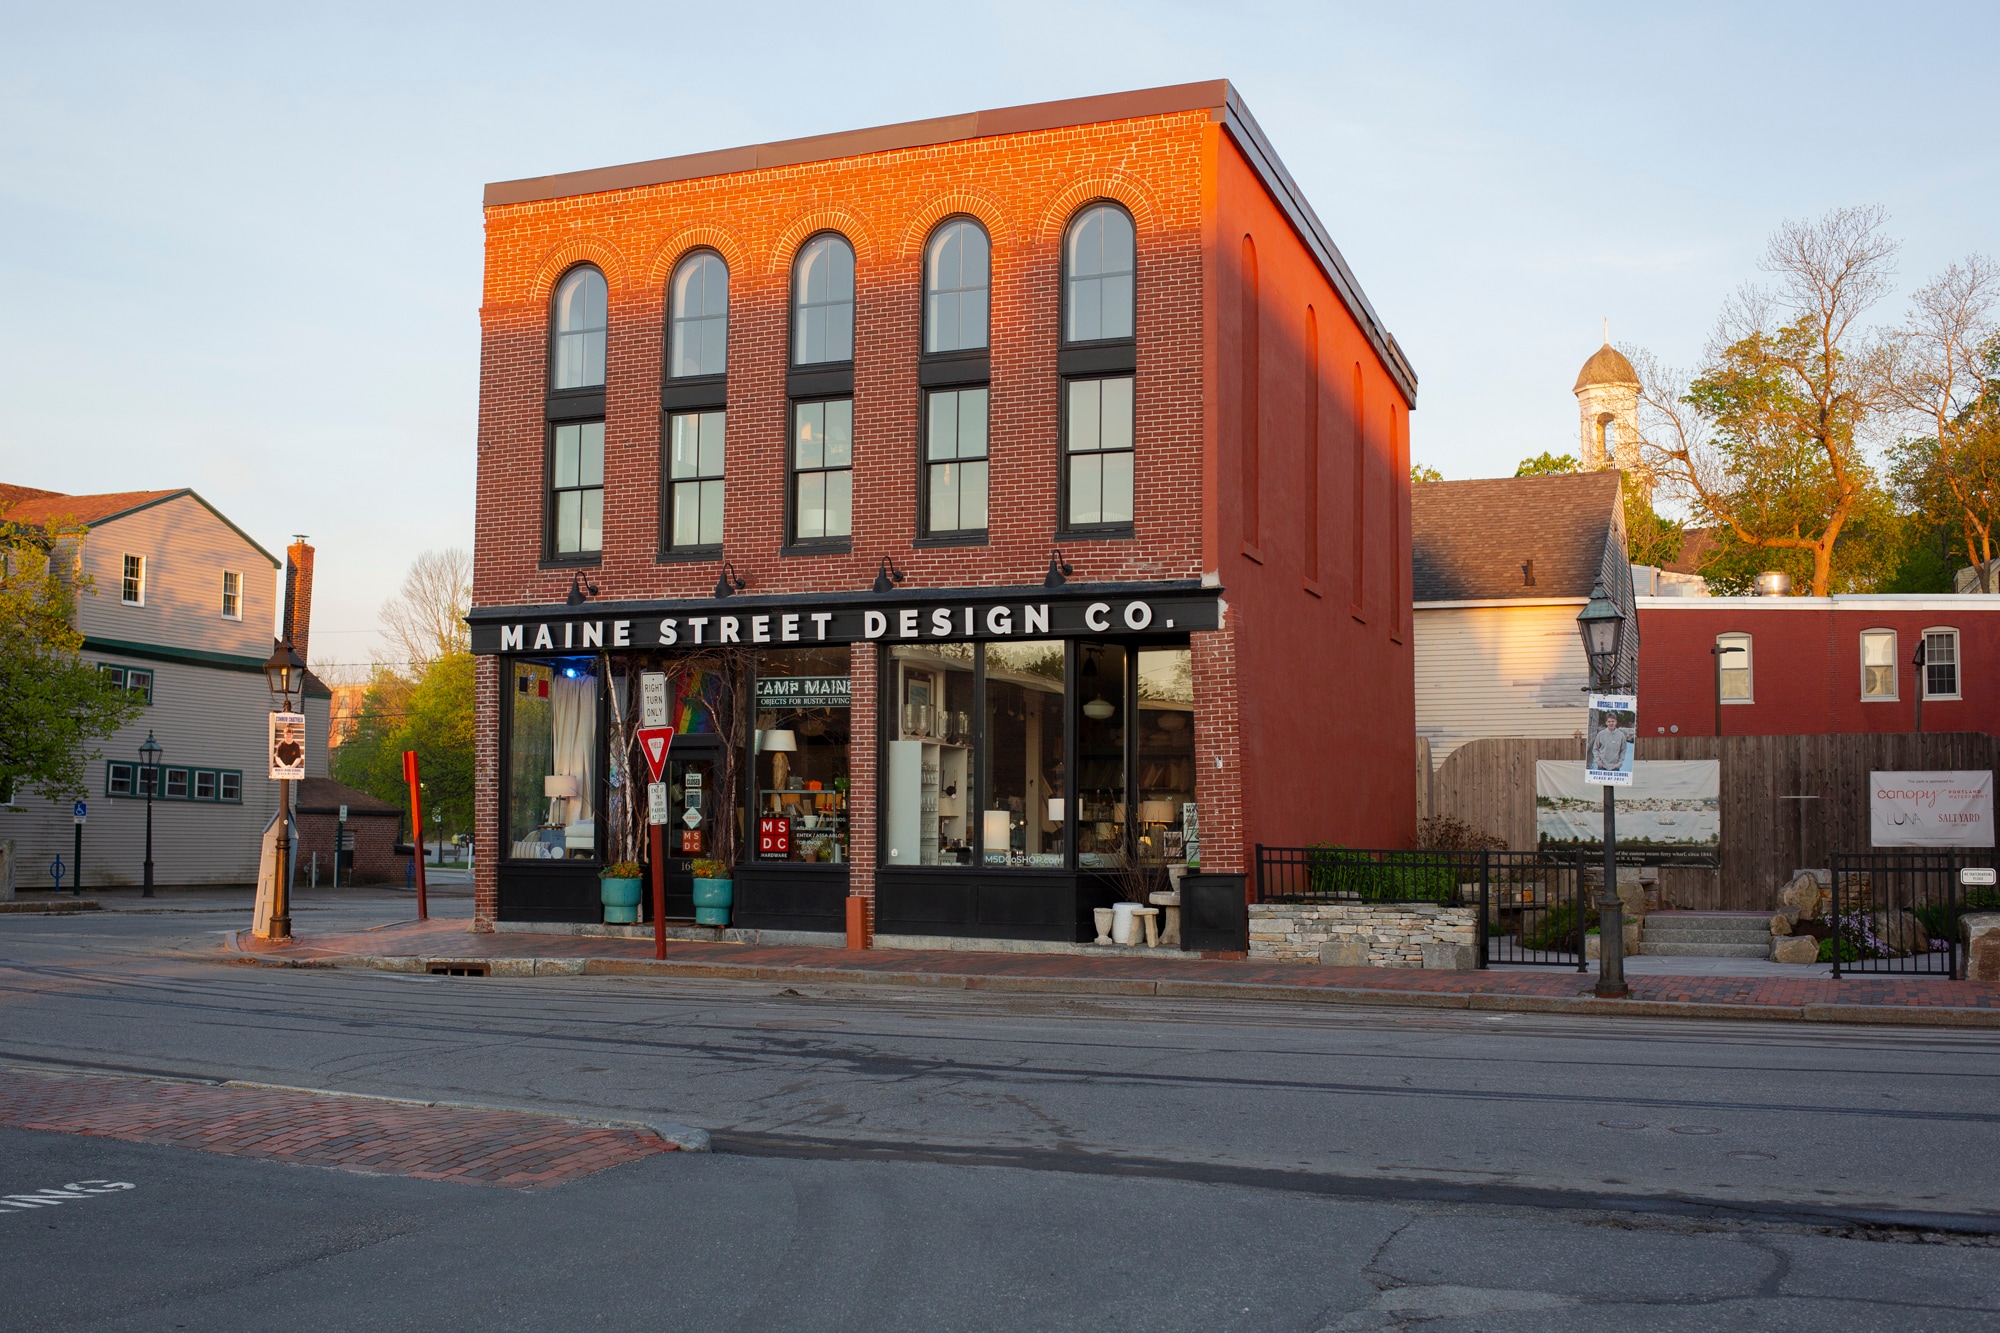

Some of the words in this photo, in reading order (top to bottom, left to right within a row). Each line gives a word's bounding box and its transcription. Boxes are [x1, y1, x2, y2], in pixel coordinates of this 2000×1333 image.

[501, 620, 631, 650] MAINE
[659, 613, 832, 645] STREET
[864, 604, 1050, 639] DESIGN
[1085, 600, 1175, 632] CO.
[644, 683, 663, 693] RIGHT
[756, 680, 799, 695] CAMP
[646, 695, 663, 705] TURN
[761, 698, 787, 706] OBJECTS
[646, 708, 663, 717] ONLY
[1877, 789, 1946, 808] canopy
[1886, 812, 1923, 826] LUNA
[1938, 813, 1958, 823] SALT
[1959, 813, 1980, 823] YARD
[985, 855, 1064, 864] MSDCoSHOP.com
